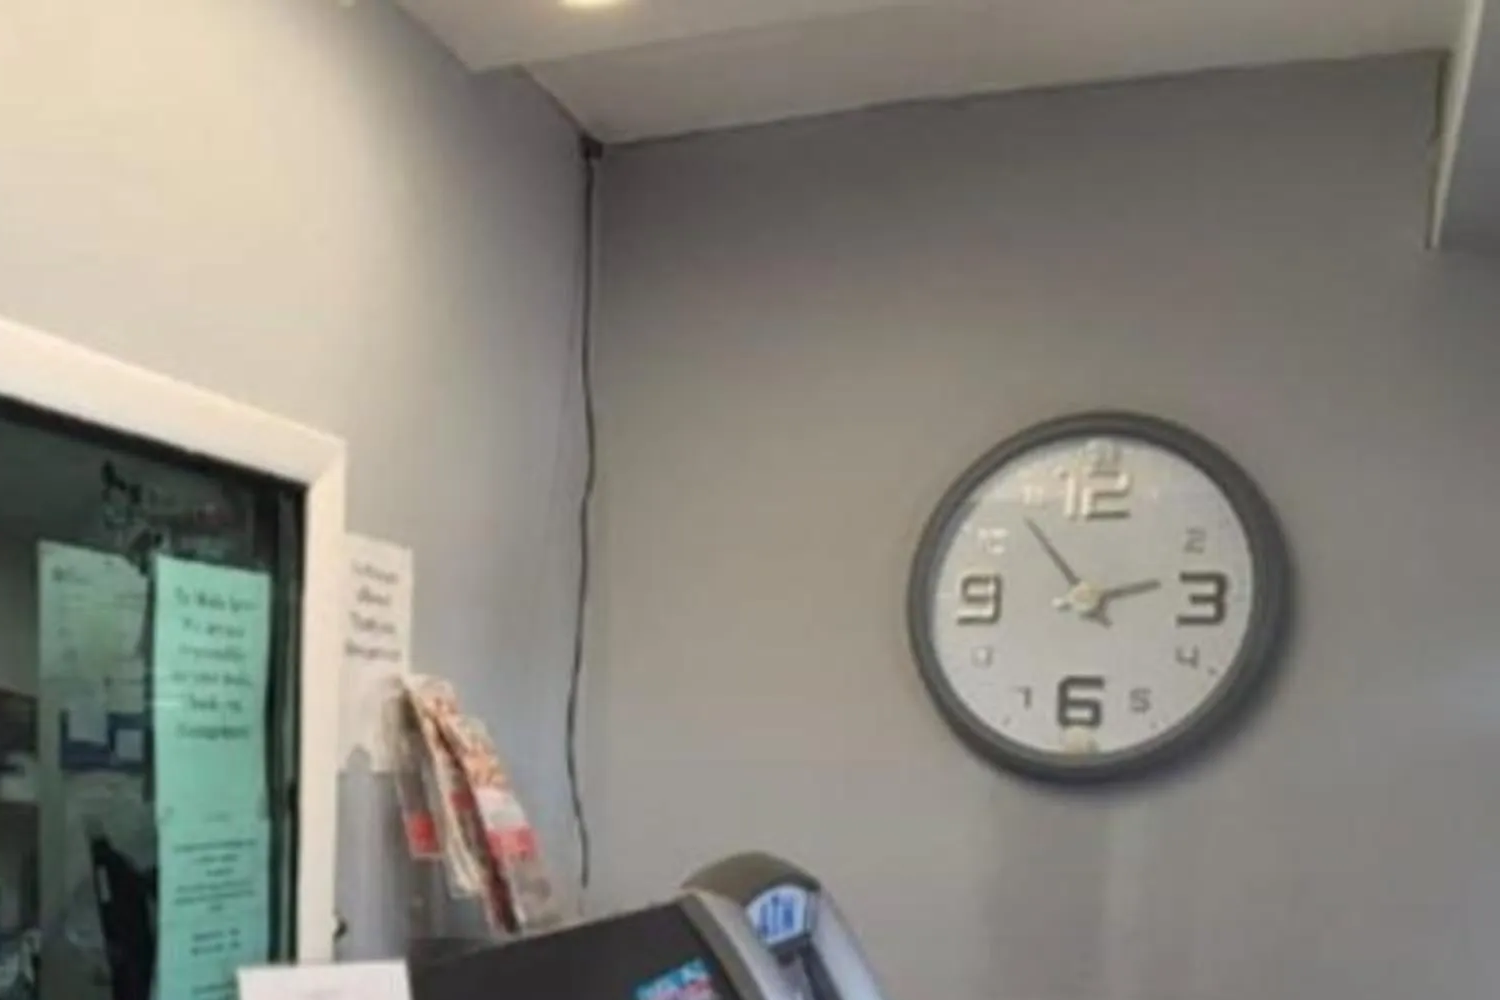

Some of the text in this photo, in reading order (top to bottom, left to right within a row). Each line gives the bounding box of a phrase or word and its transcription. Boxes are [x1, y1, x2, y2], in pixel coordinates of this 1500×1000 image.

[1053, 464, 1133, 523] 12
[956, 571, 1004, 626] 9
[1175, 570, 1230, 627] 3
[1056, 674, 1106, 730] 6
